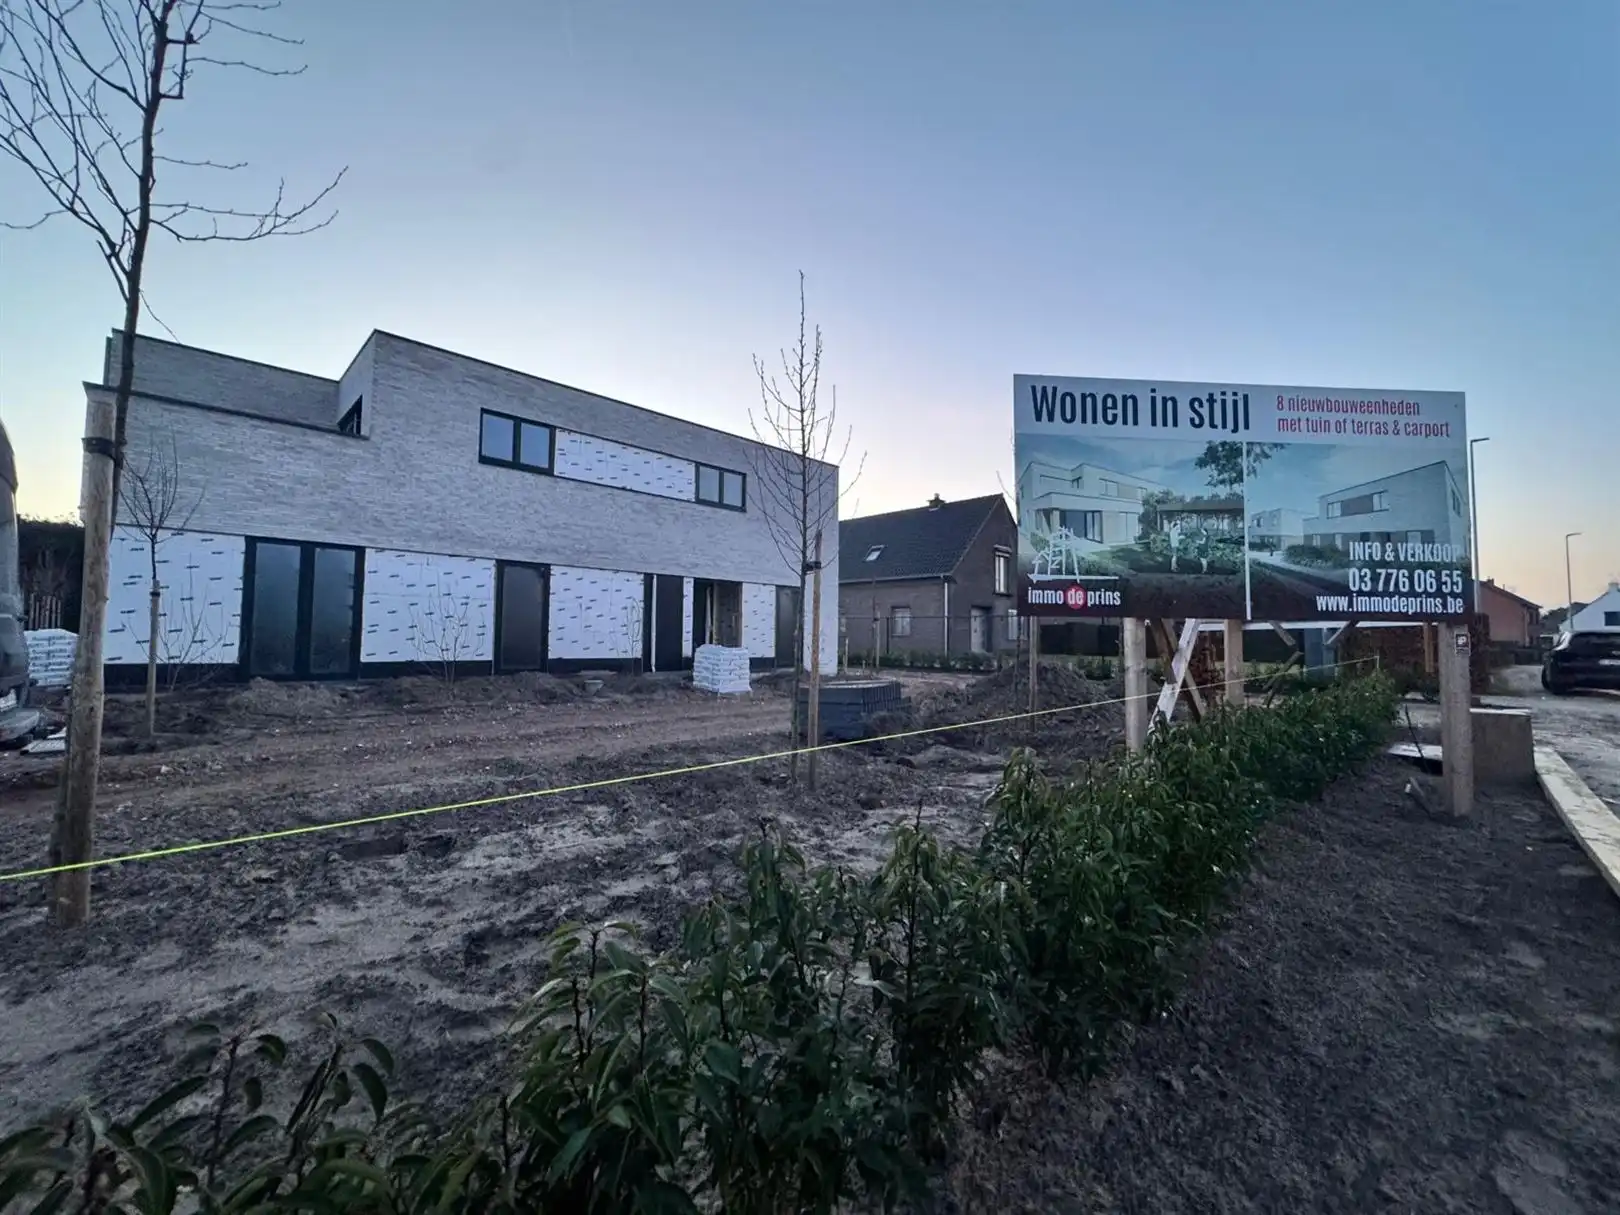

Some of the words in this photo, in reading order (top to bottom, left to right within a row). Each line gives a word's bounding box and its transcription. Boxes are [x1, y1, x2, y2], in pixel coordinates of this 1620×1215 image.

[1030, 385, 1139, 426] Wonen
[1150, 388, 1179, 428] in
[1189, 391, 1250, 434] stijl
[1276, 395, 1284, 411] 8
[1288, 395, 1420, 416] nieuwbouweenheden
[1277, 416, 1302, 433] met
[1306, 417, 1331, 434] tuin
[1335, 418, 1348, 434] of
[1351, 419, 1389, 436] terras
[1392, 420, 1400, 436] &
[1404, 421, 1450, 438] carport
[1349, 541, 1381, 561] INFO
[1384, 542, 1395, 562] &
[1397, 542, 1460, 562] VERKOOP
[1349, 568, 1372, 592] 03
[1376, 568, 1409, 593] 776
[1414, 569, 1437, 593] 06
[1441, 570, 1463, 593] 55
[1028, 586, 1064, 604] immo
[1067, 588, 1084, 605] de
[1087, 588, 1121, 607] prins
[1316, 593, 1464, 615] www.immodeprins.be
